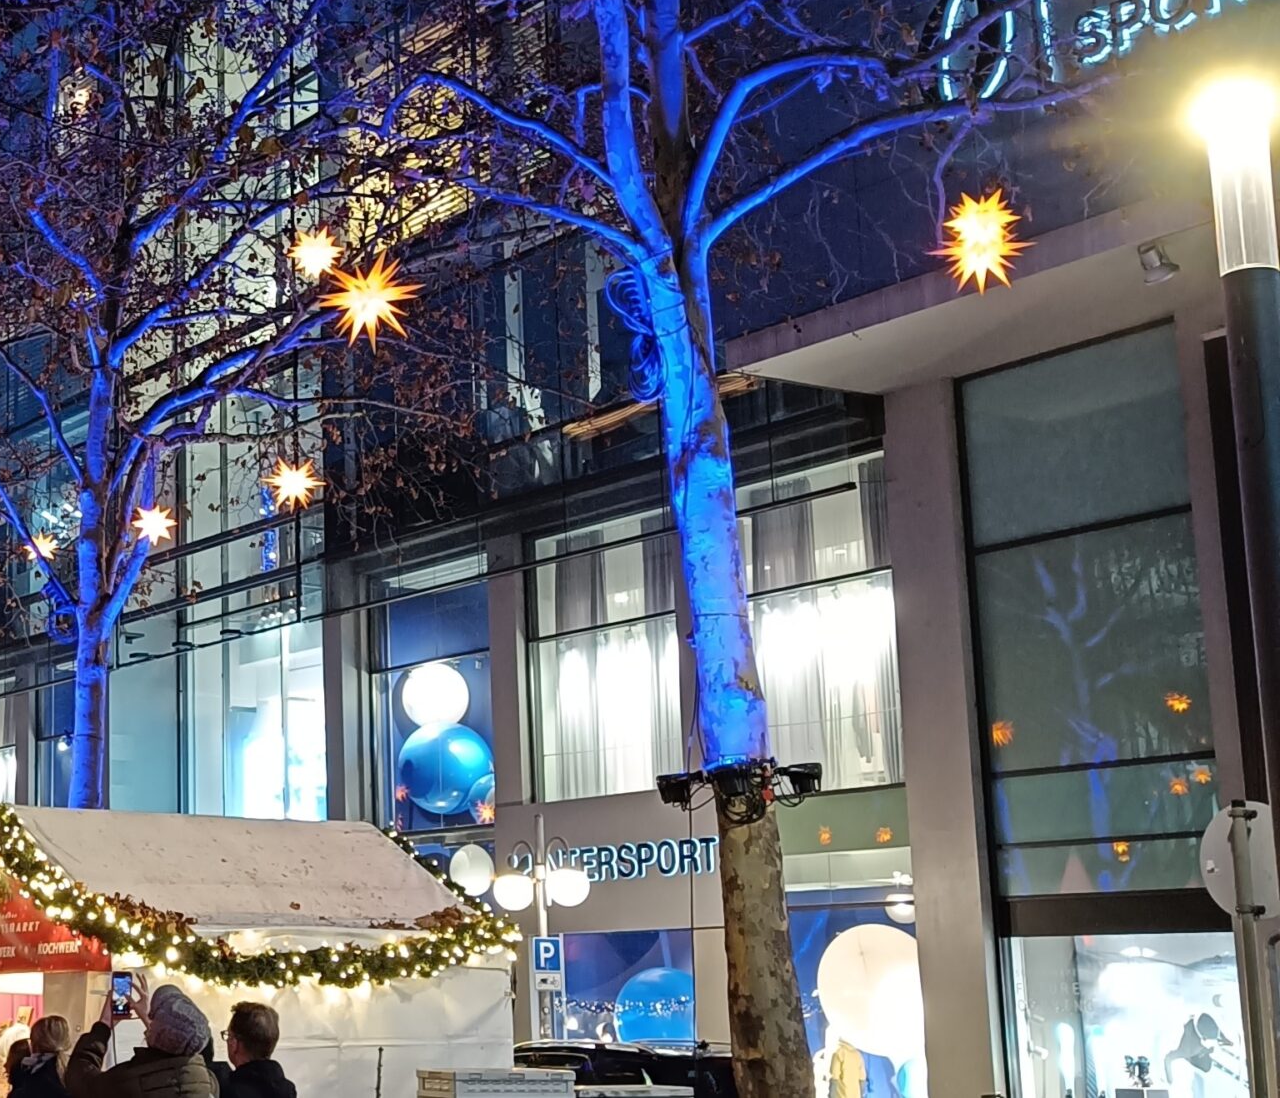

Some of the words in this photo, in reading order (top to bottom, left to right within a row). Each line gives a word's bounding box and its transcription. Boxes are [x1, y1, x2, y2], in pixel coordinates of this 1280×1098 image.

[537, 836, 720, 882] NTERSPORT
[37, 940, 80, 955] KOCHWERK
[539, 942, 555, 968] P
